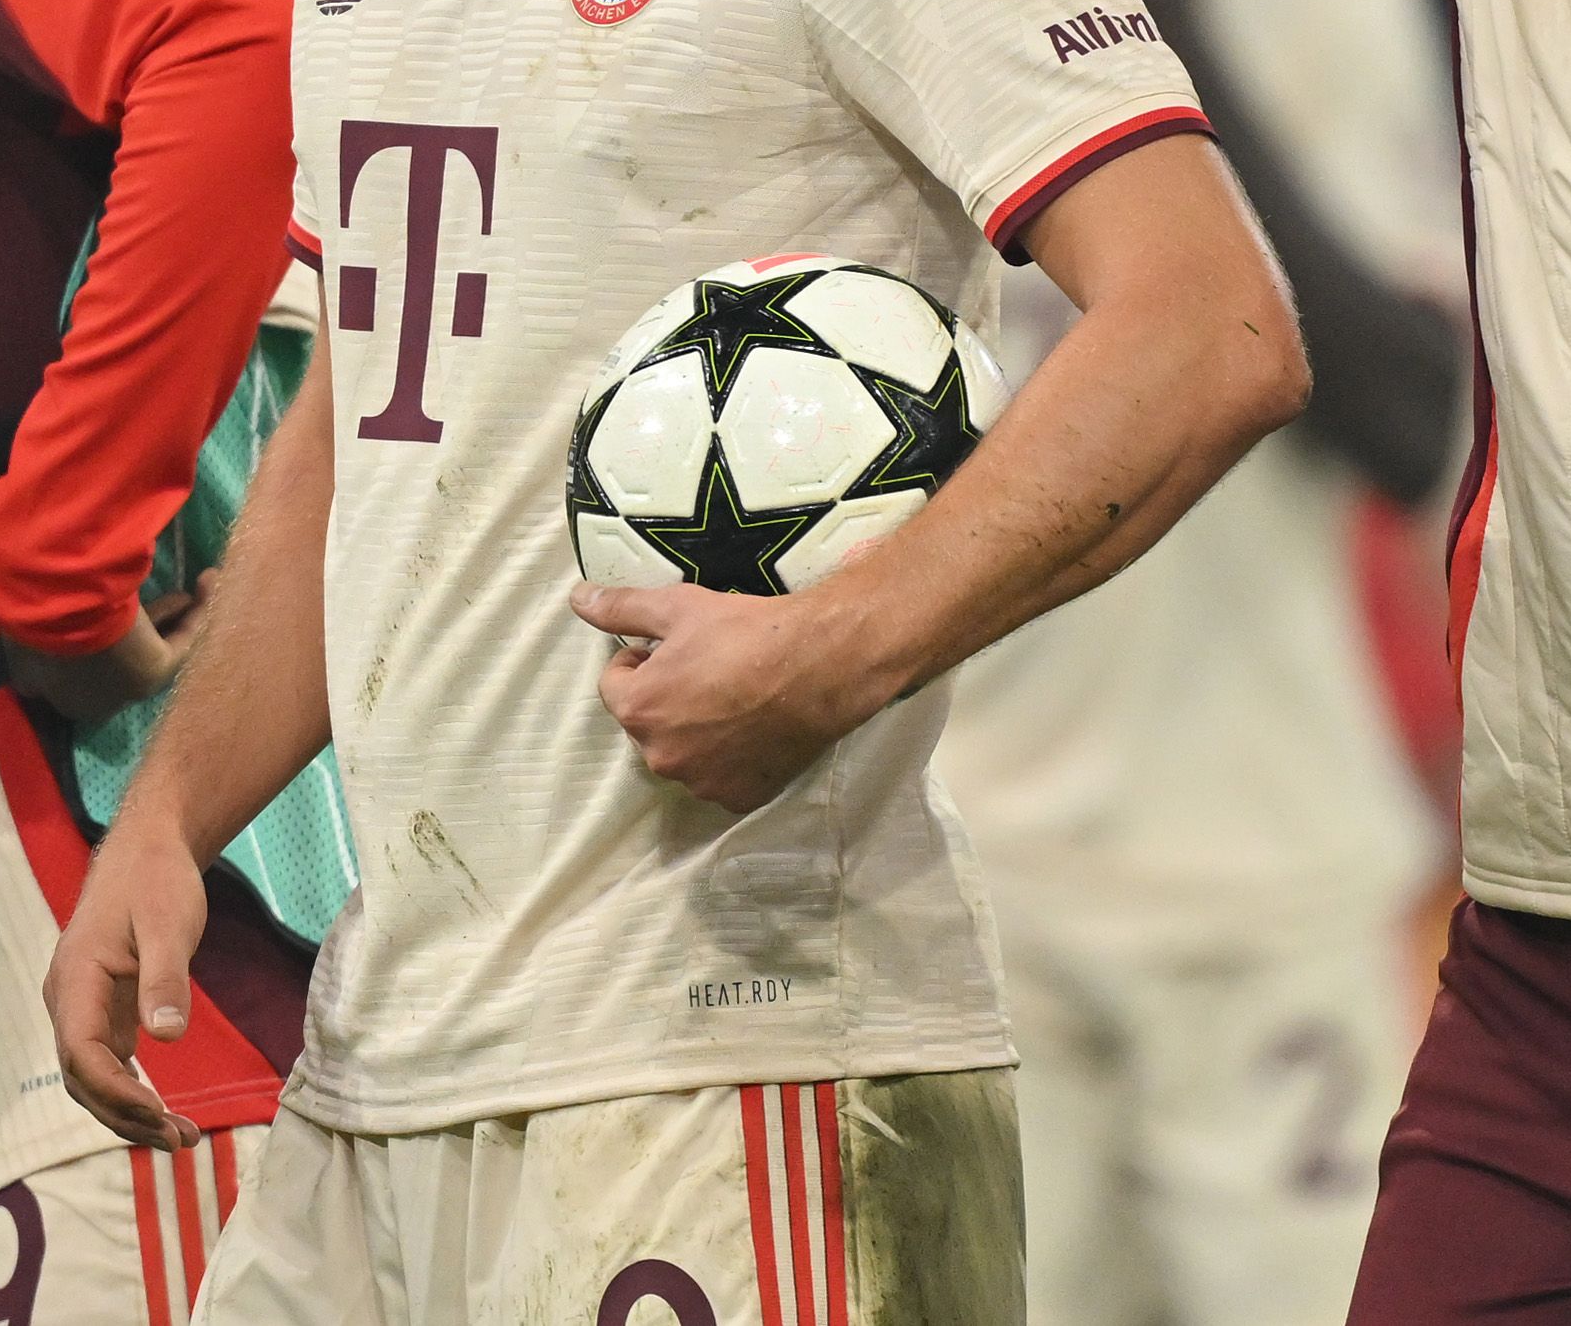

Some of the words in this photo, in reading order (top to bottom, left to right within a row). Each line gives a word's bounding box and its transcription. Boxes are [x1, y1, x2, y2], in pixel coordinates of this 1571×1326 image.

[1042, 6, 1163, 64] Allian
[338, 119, 499, 444] T
[688, 977, 792, 1008] HEAT.RDY
